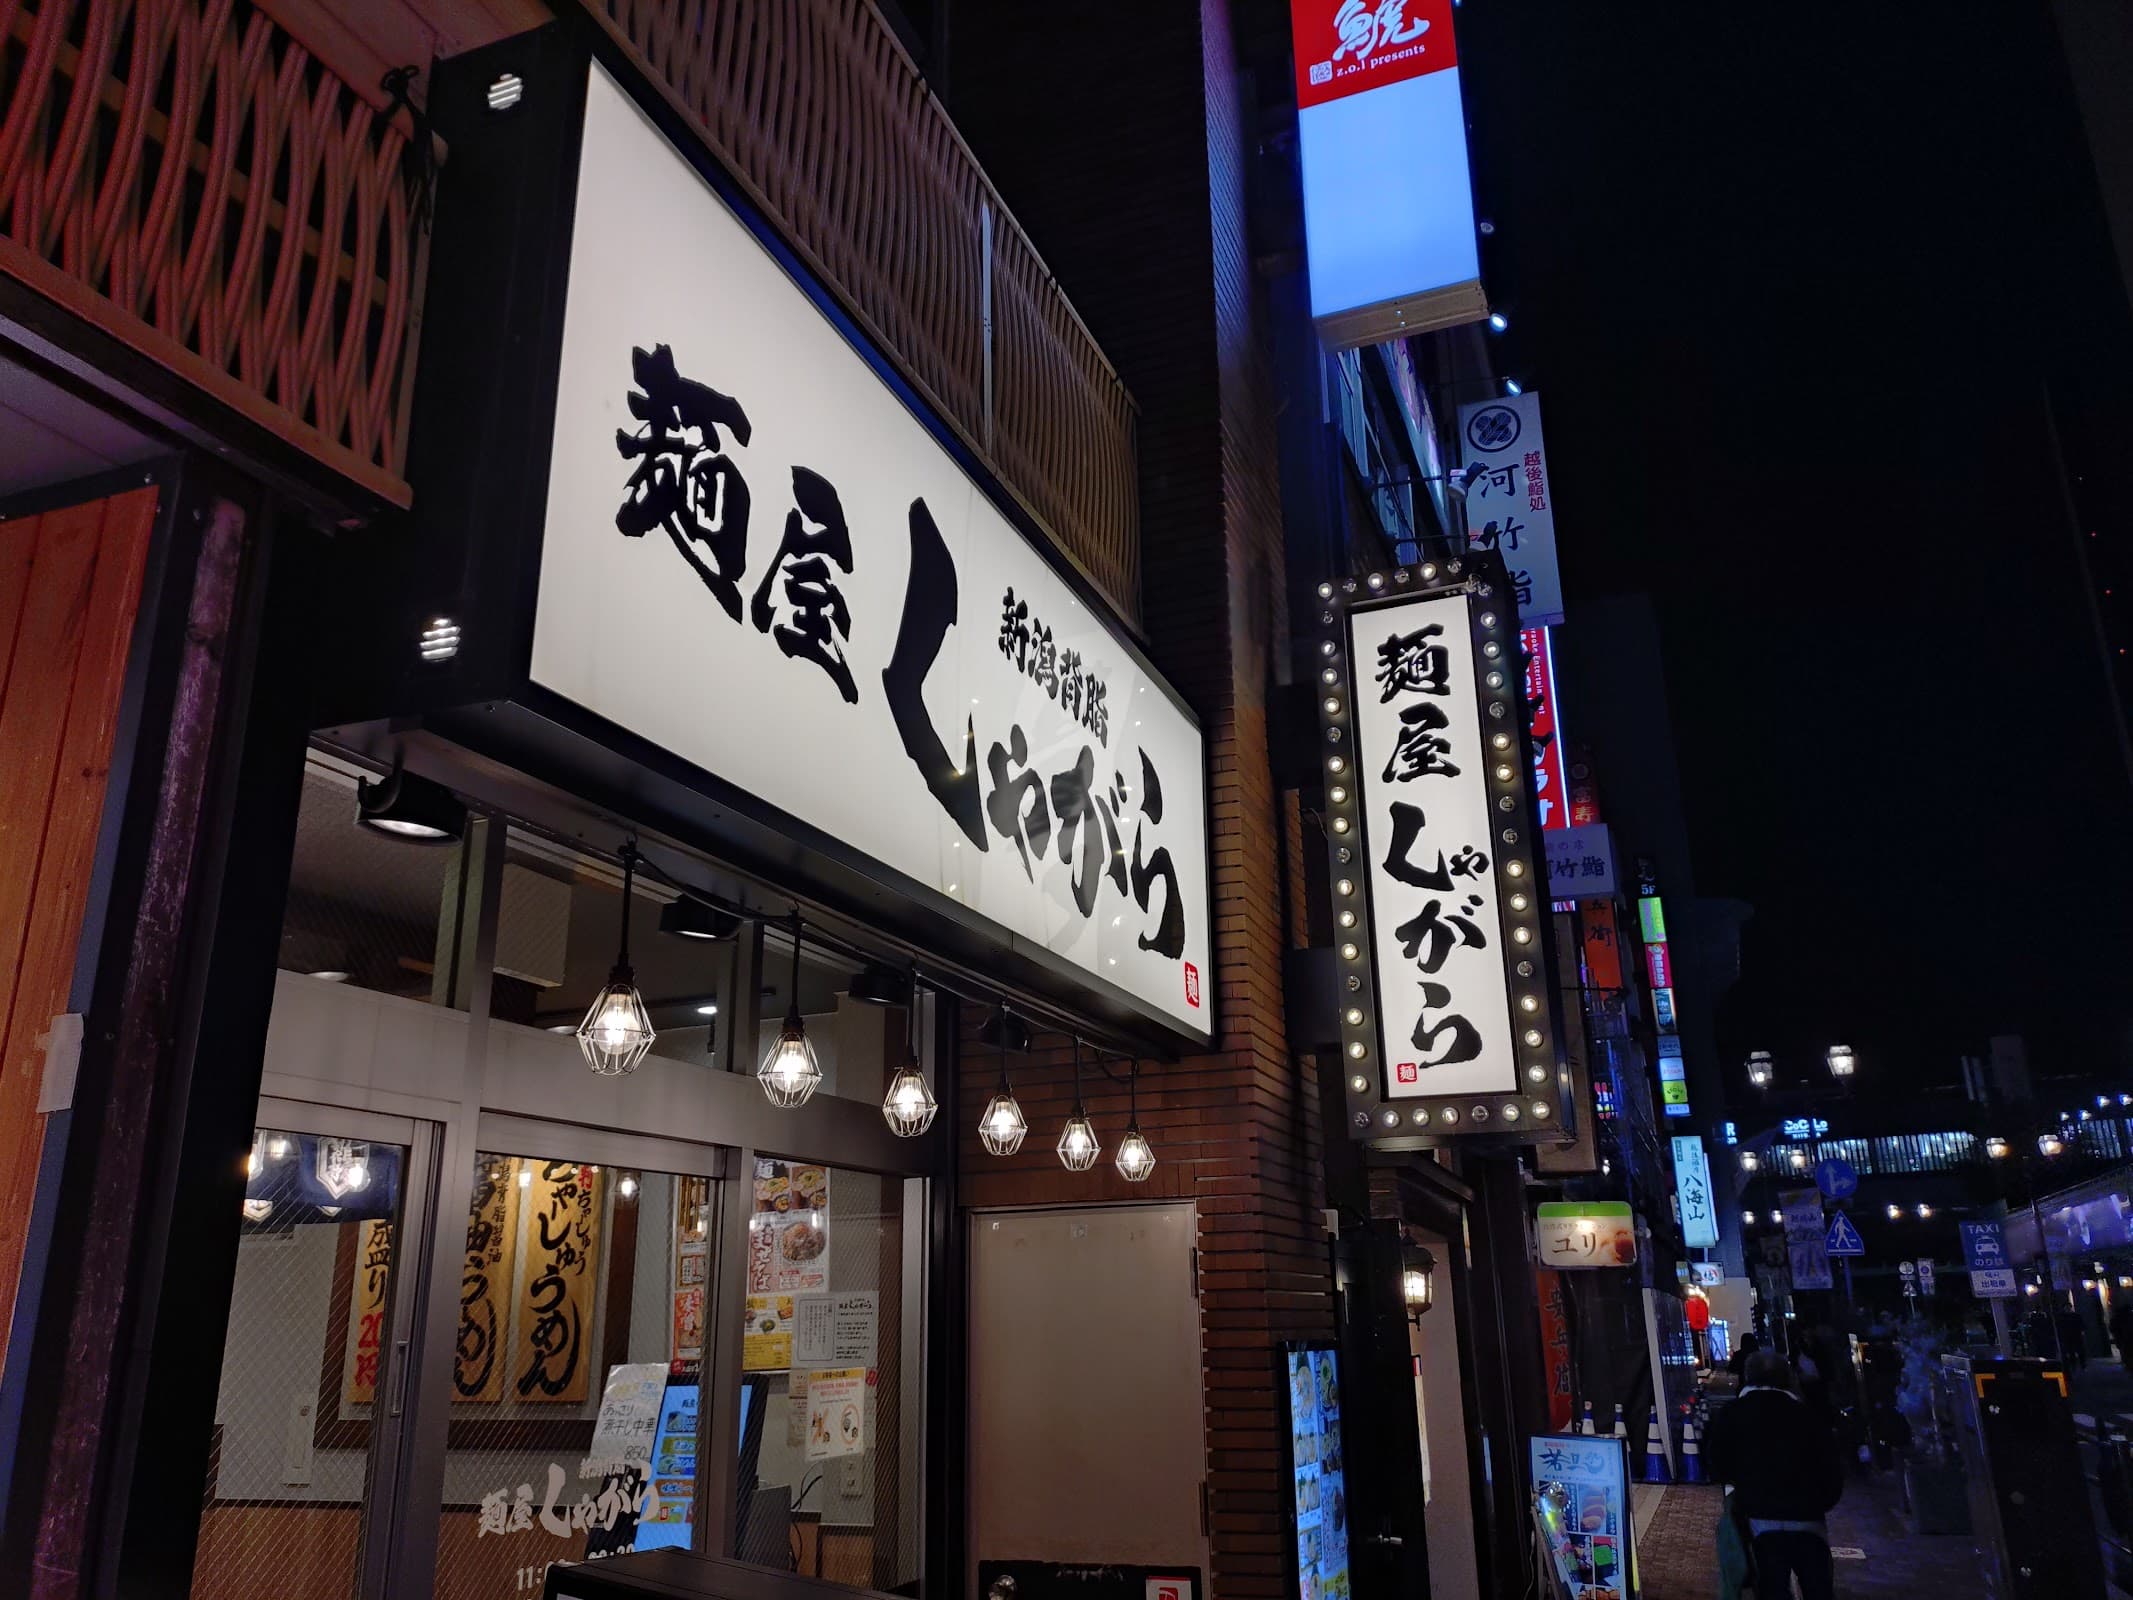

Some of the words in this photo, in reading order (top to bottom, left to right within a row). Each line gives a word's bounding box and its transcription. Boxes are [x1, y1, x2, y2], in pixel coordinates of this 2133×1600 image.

[1370, 44, 1426, 69] presents
[1524, 451, 1546, 512] 越後鮨処
[998, 586, 1108, 748] 新潟背脂
[1375, 623, 1490, 1069] 麺屋しゃがら
[1684, 1174, 1705, 1221] 八海山
[1552, 1232, 1597, 1257] ユリ
[1967, 1223, 2001, 1234] TAXI
[601, 1417, 657, 1436] 煮干し中華
